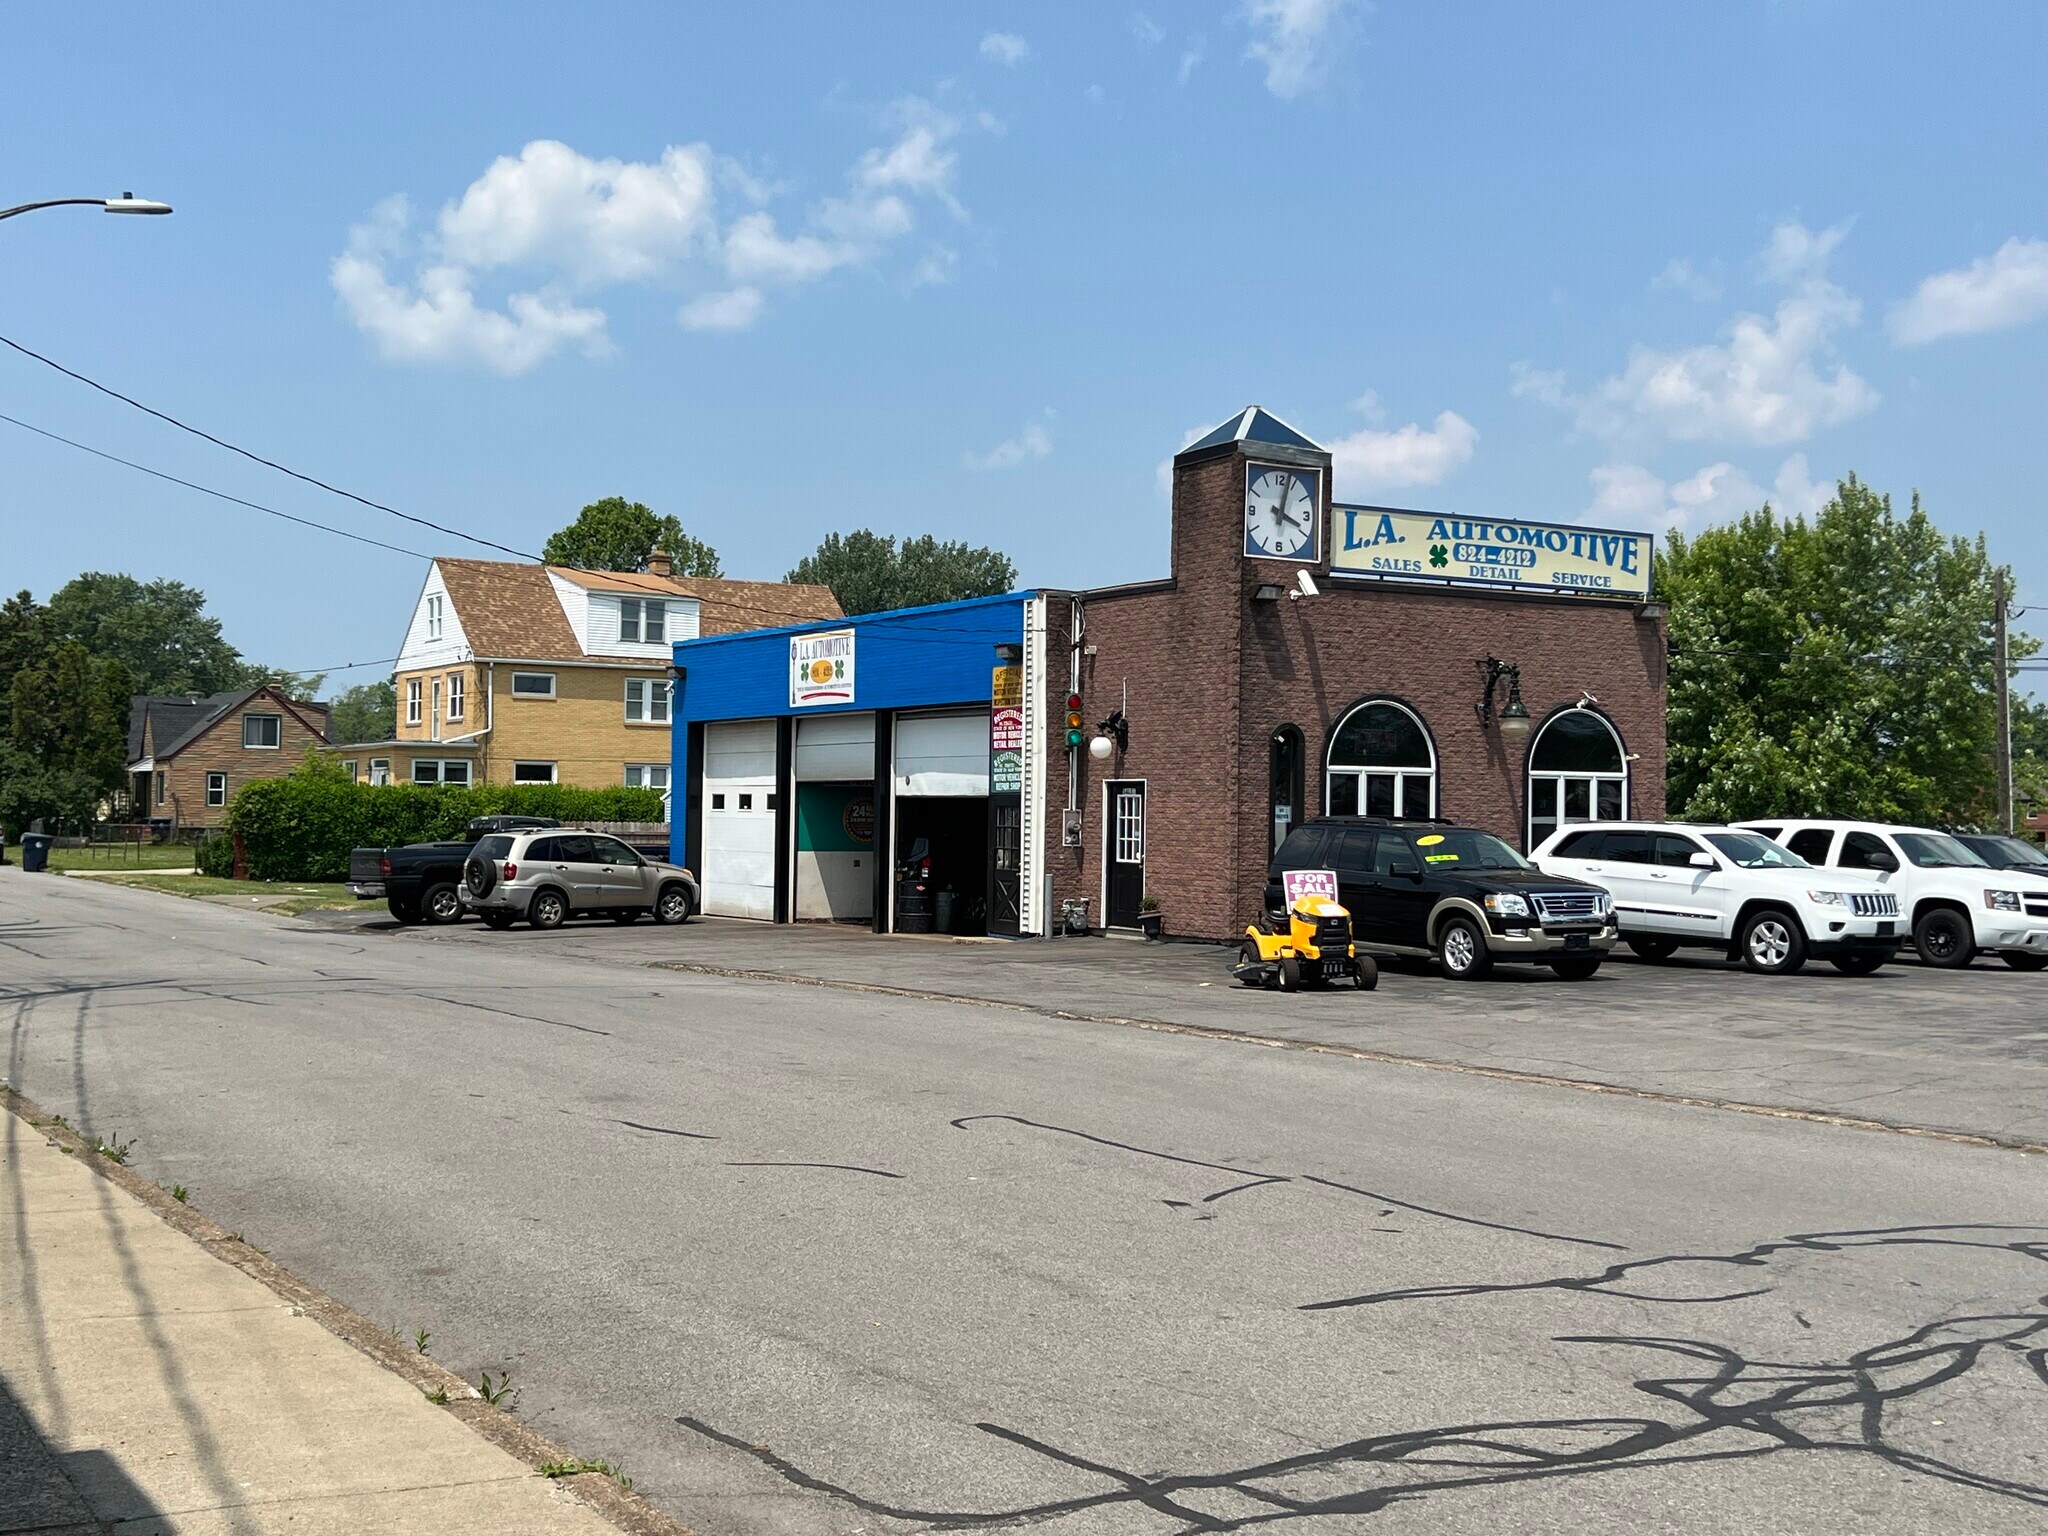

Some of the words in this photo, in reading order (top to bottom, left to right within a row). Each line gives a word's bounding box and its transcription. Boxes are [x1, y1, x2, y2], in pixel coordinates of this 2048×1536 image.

[1275, 474, 1285, 486] 12
[1248, 505, 1256, 516] 9
[1302, 511, 1310, 521] 3
[1275, 541, 1283, 552] 6
[1343, 511, 1406, 551] L.A.
[1426, 519, 1638, 576] AUTOMOTIVE
[1457, 545, 1531, 567] 824-4212
[1372, 557, 1422, 572] SALES
[1469, 565, 1522, 581] DETAIL
[1552, 571, 1612, 588] SERVICE
[812, 637, 851, 659] AUTOMOTIVE
[994, 710, 1022, 724] REGISTERED
[994, 752, 1022, 767] REGISTERED
[1010, 782, 1021, 790] SHOP
[1295, 874, 1327, 883] FOR
[1290, 883, 1334, 894] SALE
